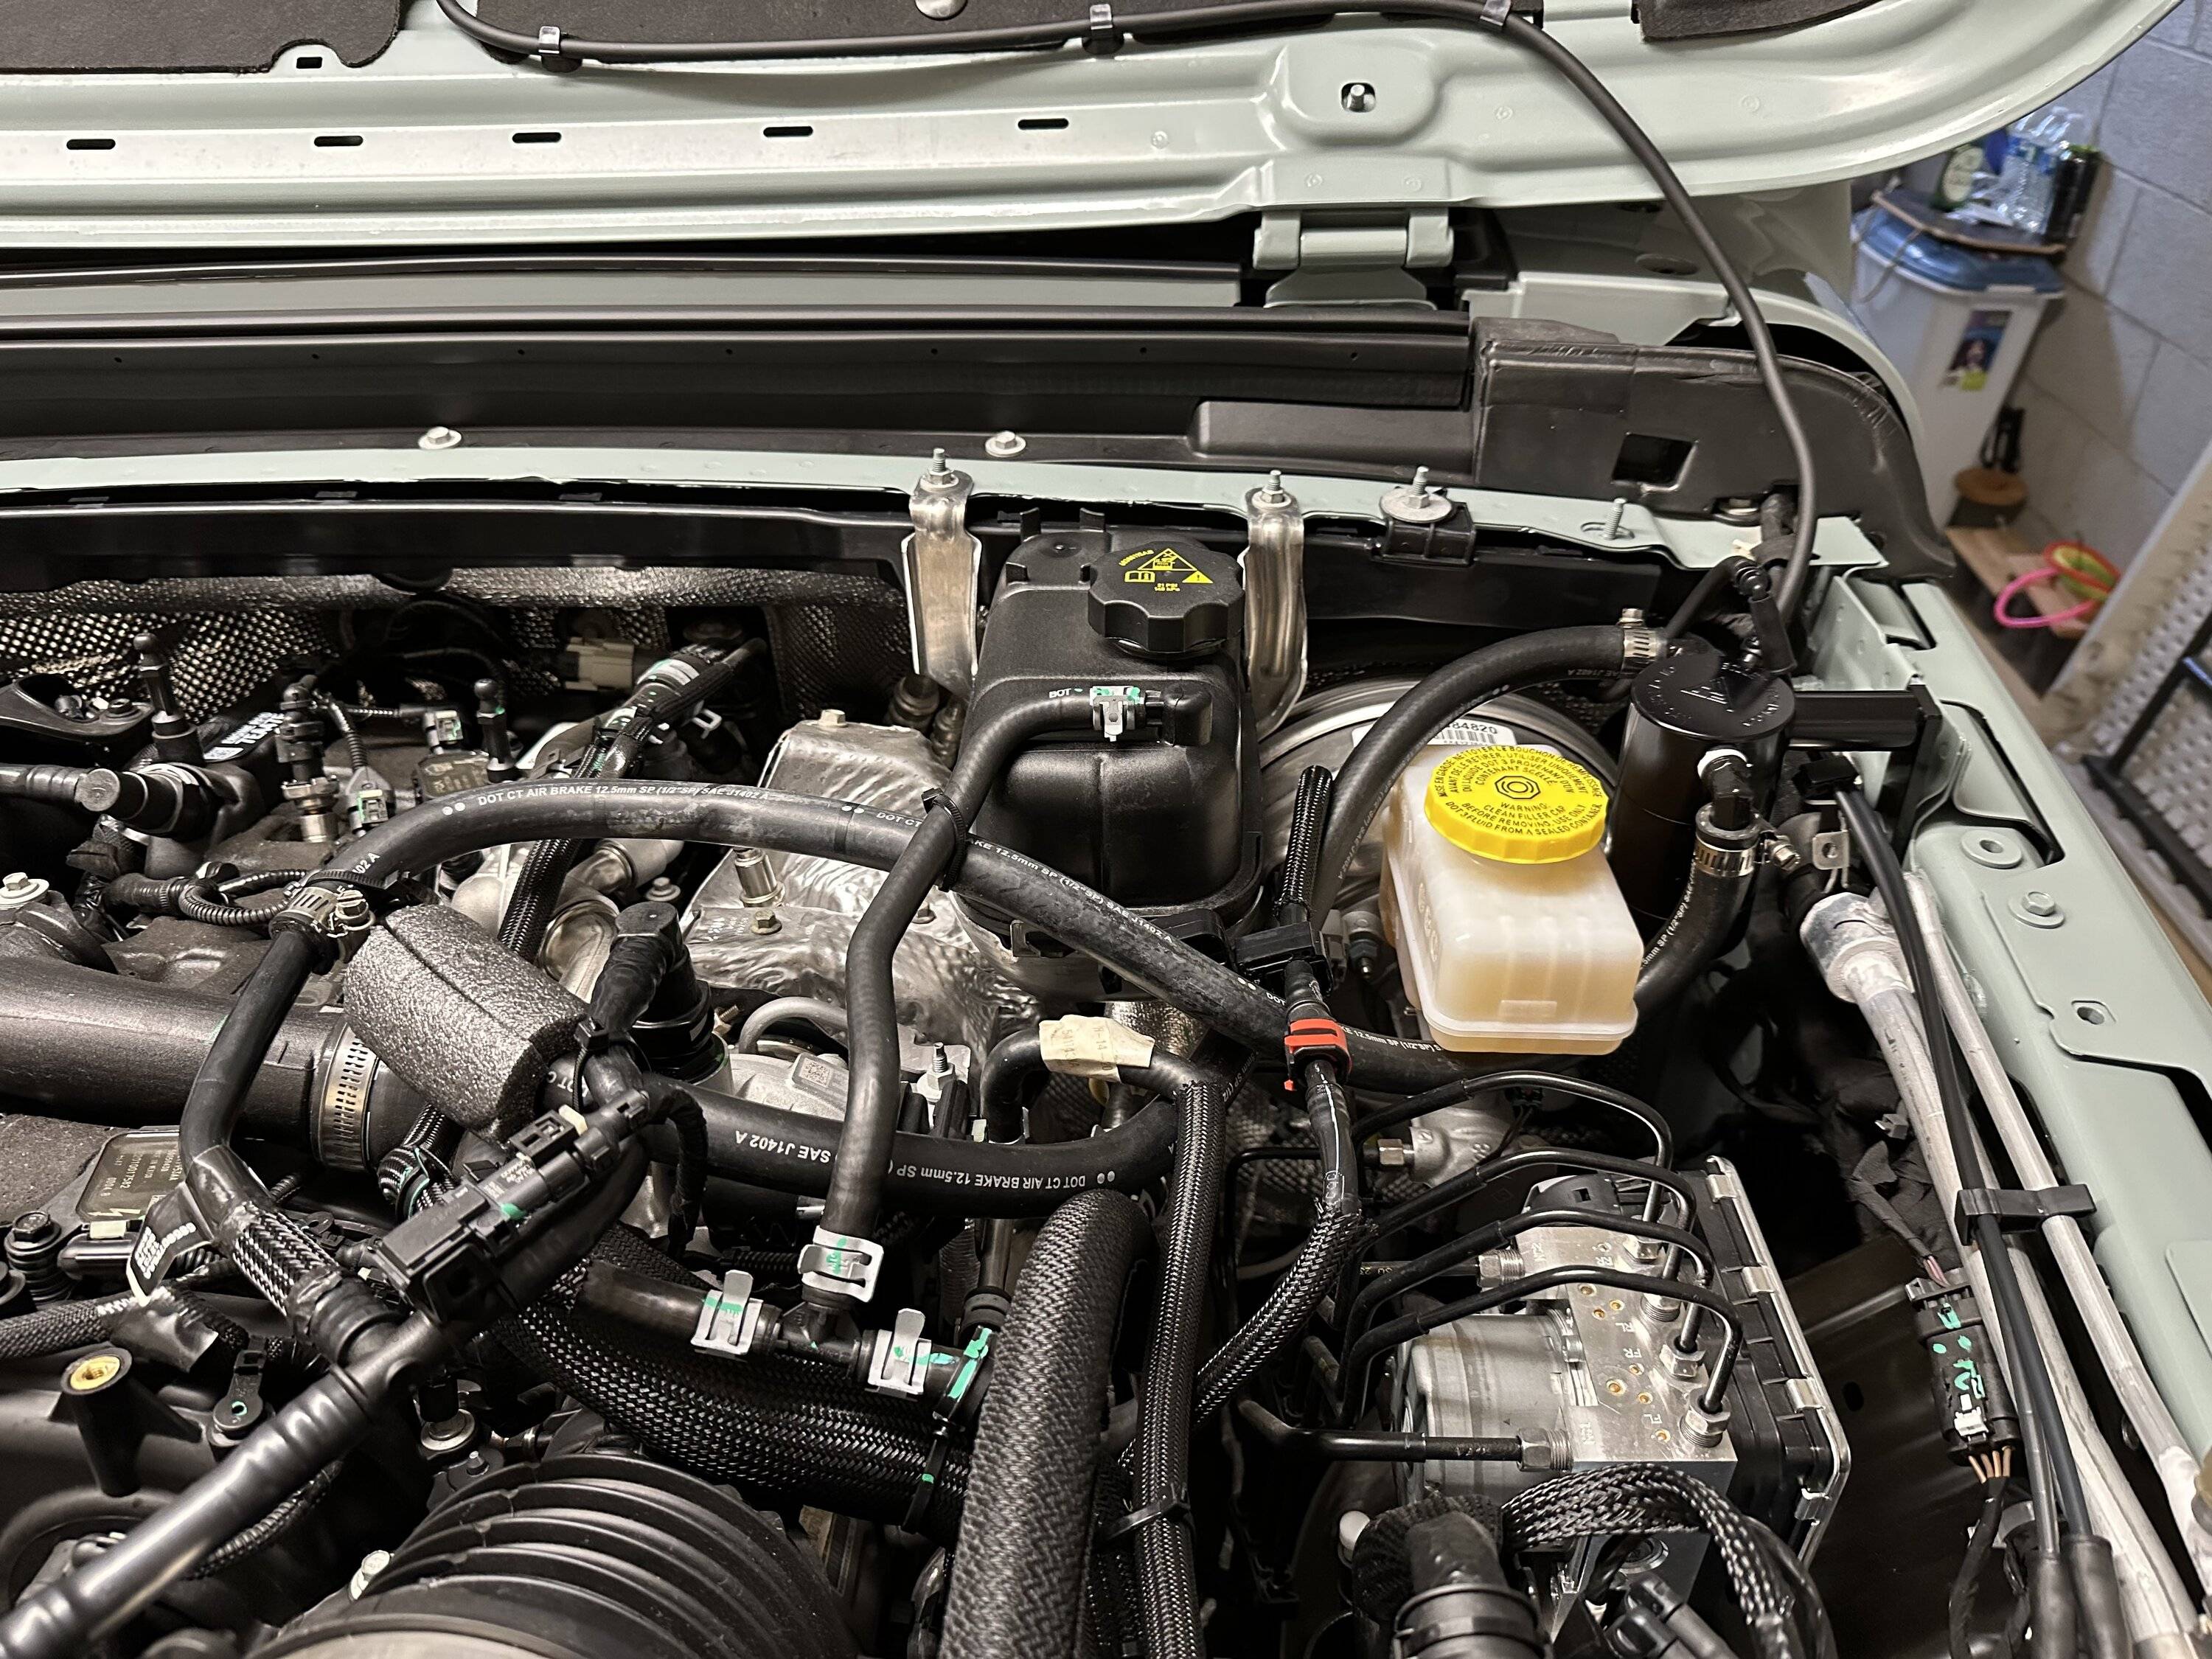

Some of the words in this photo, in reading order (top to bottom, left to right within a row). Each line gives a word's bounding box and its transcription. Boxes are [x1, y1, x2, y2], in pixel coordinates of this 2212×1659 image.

[1048, 688, 1072, 699] BOT
[1509, 745, 1555, 759] BOUCHON
[1448, 776, 1459, 793] AVANT
[1506, 753, 1547, 765] UTILISER
[1548, 762, 1589, 794] UNIQUEMENT
[1475, 765, 1519, 785] CONTENANT
[1480, 758, 1500, 768] DOT
[1510, 759, 1563, 780] PROVENANT
[478, 792, 504, 806] DOT
[507, 790, 524, 800] CT
[526, 787, 548, 798] AIR
[549, 785, 593, 796] BRAKE
[596, 785, 637, 795] 12.5mm
[639, 786, 655, 794] SP
[701, 787, 725, 796] SAE
[726, 788, 759, 799] J1402
[759, 792, 768, 801] A
[1445, 801, 1464, 813] DOT
[1467, 815, 1493, 827] FLUID
[1495, 824, 1523, 835] FROM
[1534, 825, 1571, 835] SEALED
[1569, 804, 1602, 830] CONTAINER
[1461, 802, 1497, 821] BEFORE
[1553, 815, 1572, 824] USE
[1568, 804, 1587, 817] ONLY
[1484, 804, 1515, 818] CLEAN
[1519, 812, 1551, 821] FILLER
[1550, 805, 1565, 816] CAP
[368, 852, 380, 863] A
[876, 812, 905, 824] DOT
[905, 818, 922, 828] CT
[995, 847, 1039, 871] 12.5mm
[1040, 867, 1059, 879] SP
[1105, 902, 1130, 917] SAE
[1130, 916, 1163, 936] J1402
[1164, 934, 1173, 944] A
[1657, 933, 1667, 947] SP
[1266, 992, 1287, 1006] DOT
[1354, 1030, 1387, 1045] 12.5mm
[1387, 1038, 1399, 1046] SP
[735, 1130, 748, 1144] A
[749, 1134, 796, 1155] J1402
[797, 1145, 832, 1164] SAE
[897, 1164, 917, 1178] SP
[921, 1166, 970, 1185] 12.5mm
[974, 1174, 1020, 1189] BRAKE
[1023, 1176, 1043, 1189] AIR
[1046, 1176, 1061, 1189] CT
[1063, 1175, 1086, 1189] DOT
[1595, 1256, 1613, 1267] RR
[1615, 1321, 1635, 1333] RL
[1623, 1348, 1642, 1359] FR
[1644, 1413, 1662, 1425] FL
